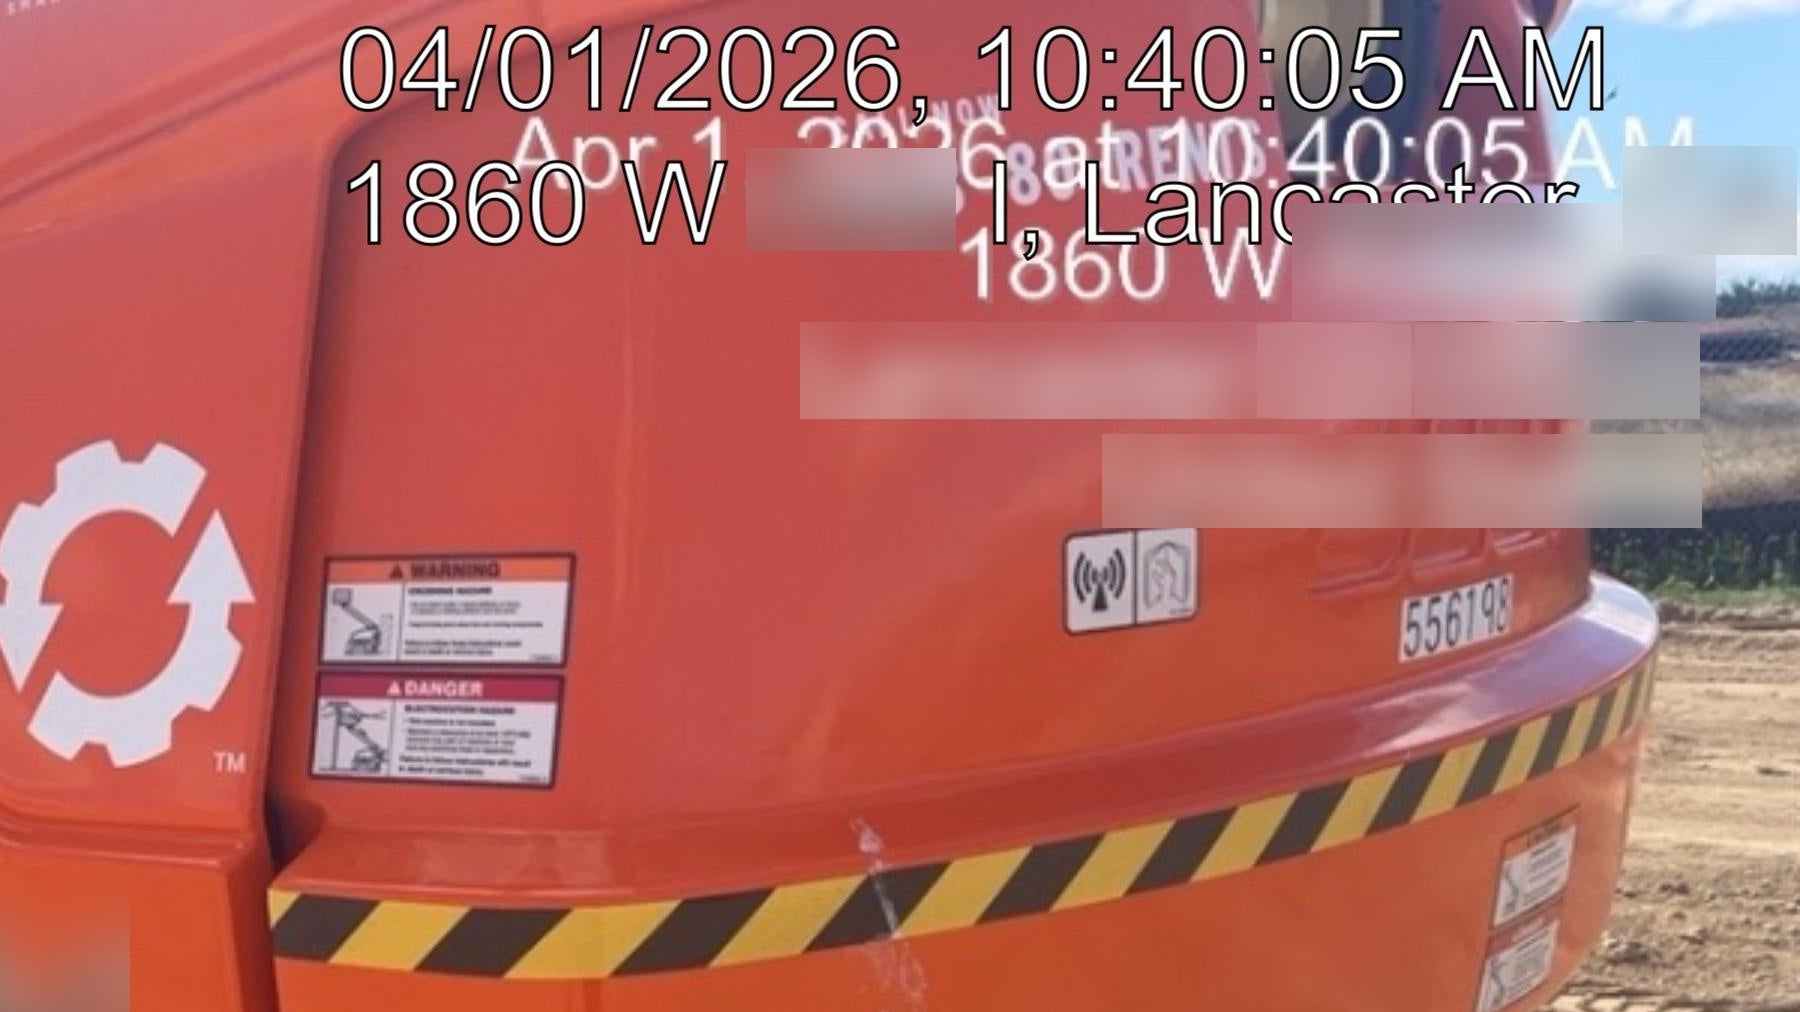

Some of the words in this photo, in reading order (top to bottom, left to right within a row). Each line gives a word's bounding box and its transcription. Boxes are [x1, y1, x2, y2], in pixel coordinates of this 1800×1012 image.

[411, 562, 501, 579] WARNING
[1404, 577, 1508, 658] 556198
[404, 680, 484, 697] DANGER
